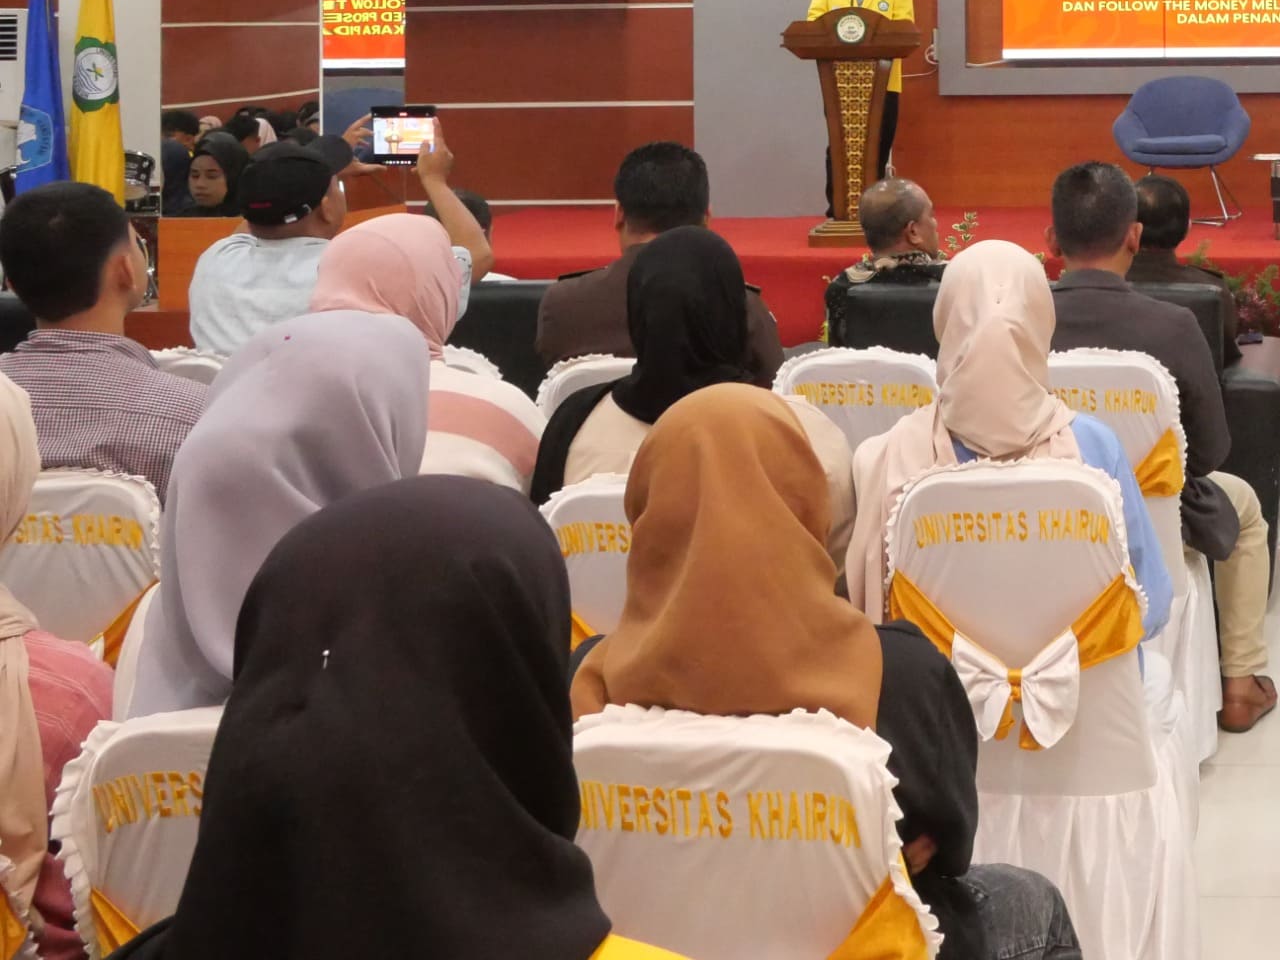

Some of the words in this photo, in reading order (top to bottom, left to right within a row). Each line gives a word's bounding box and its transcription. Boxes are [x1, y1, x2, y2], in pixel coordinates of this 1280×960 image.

[1062, 1, 1095, 12] DAN
[1098, 1, 1158, 12] FOLLOW
[1162, 0, 1190, 11] THE
[1194, 0, 1248, 11] MONEY
[1177, 13, 1229, 24] DALAM
[913, 511, 1028, 549] UNIVERSITAS
[1038, 509, 1110, 545] KHAIRUN
[747, 791, 861, 848] KHAIRUN
